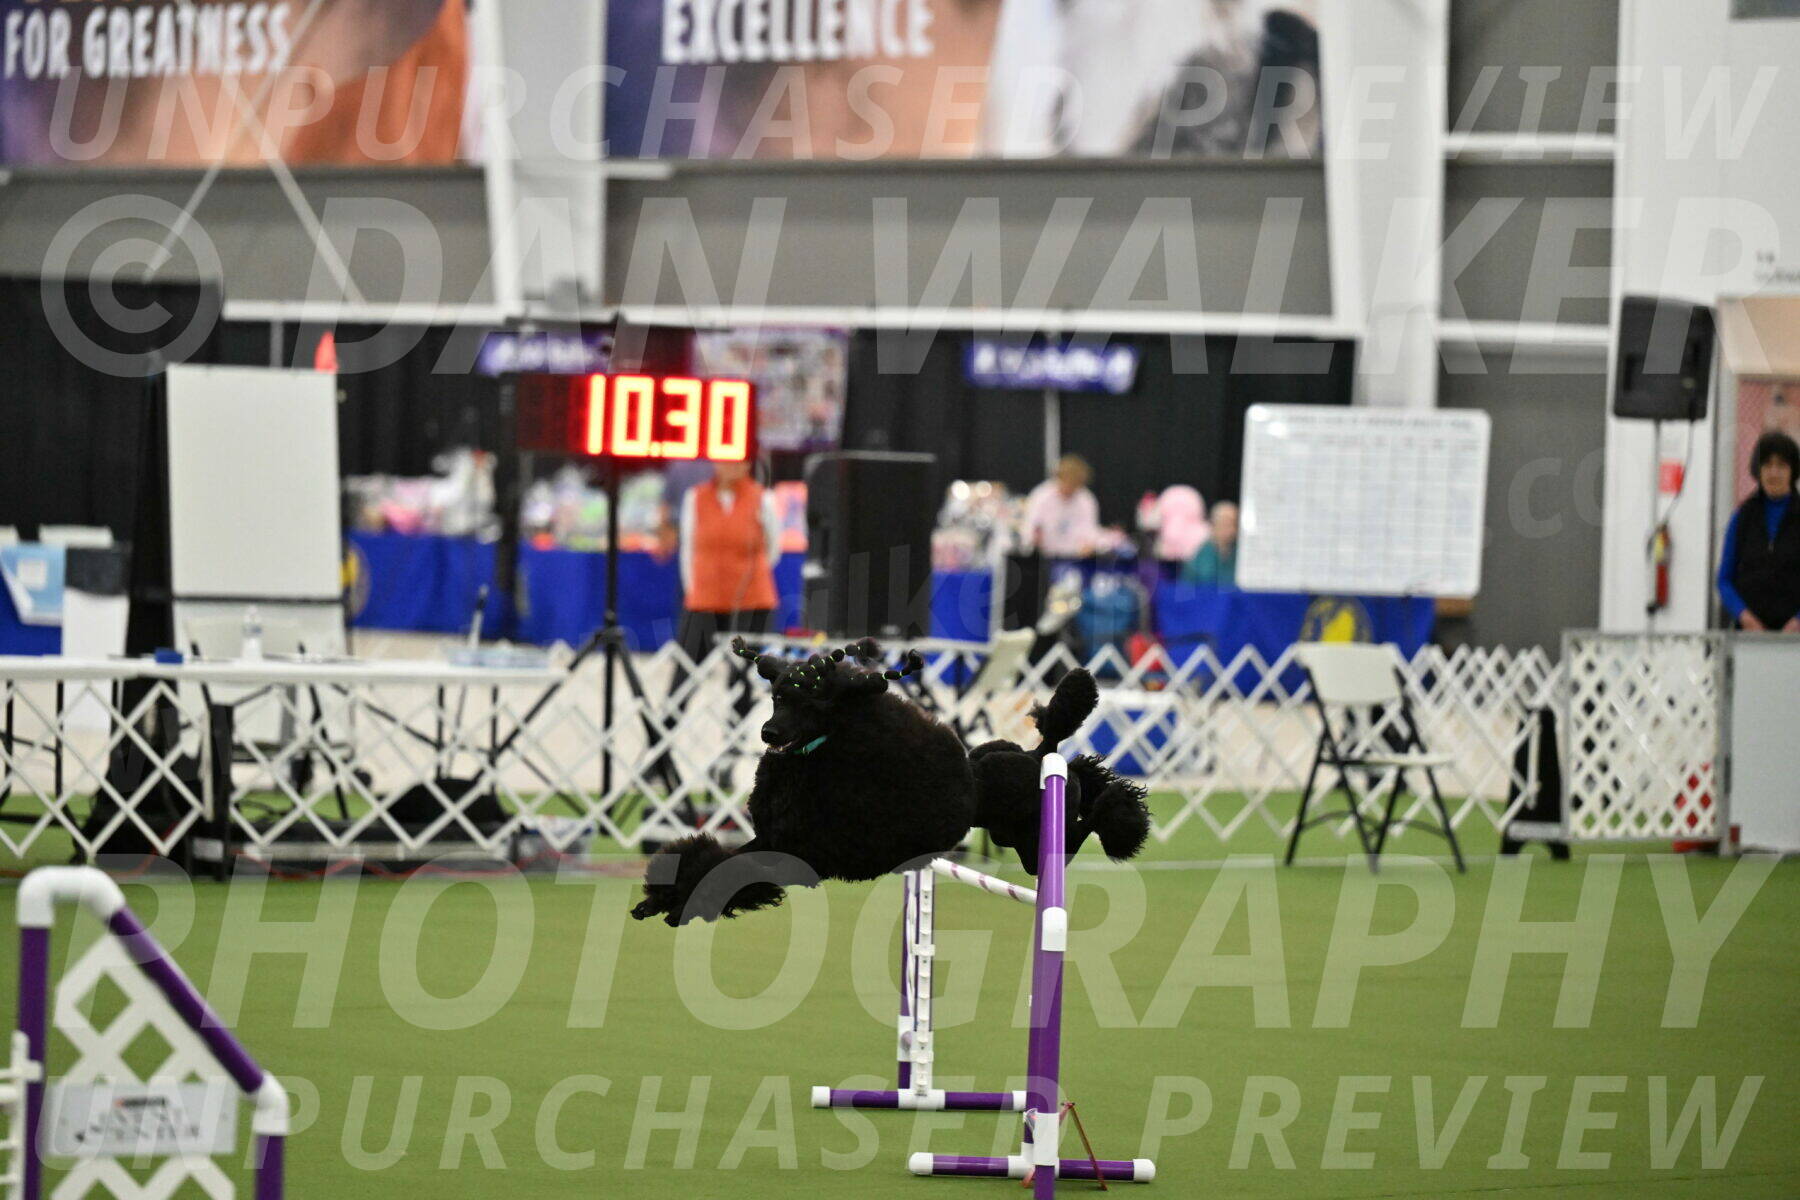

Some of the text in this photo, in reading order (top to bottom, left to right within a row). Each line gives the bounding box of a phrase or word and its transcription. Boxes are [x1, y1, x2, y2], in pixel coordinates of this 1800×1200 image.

[4, 3, 293, 79] FOR GREATNESS
[662, 0, 936, 64] EXCELLENCE
[586, 373, 751, 462] 10.30
